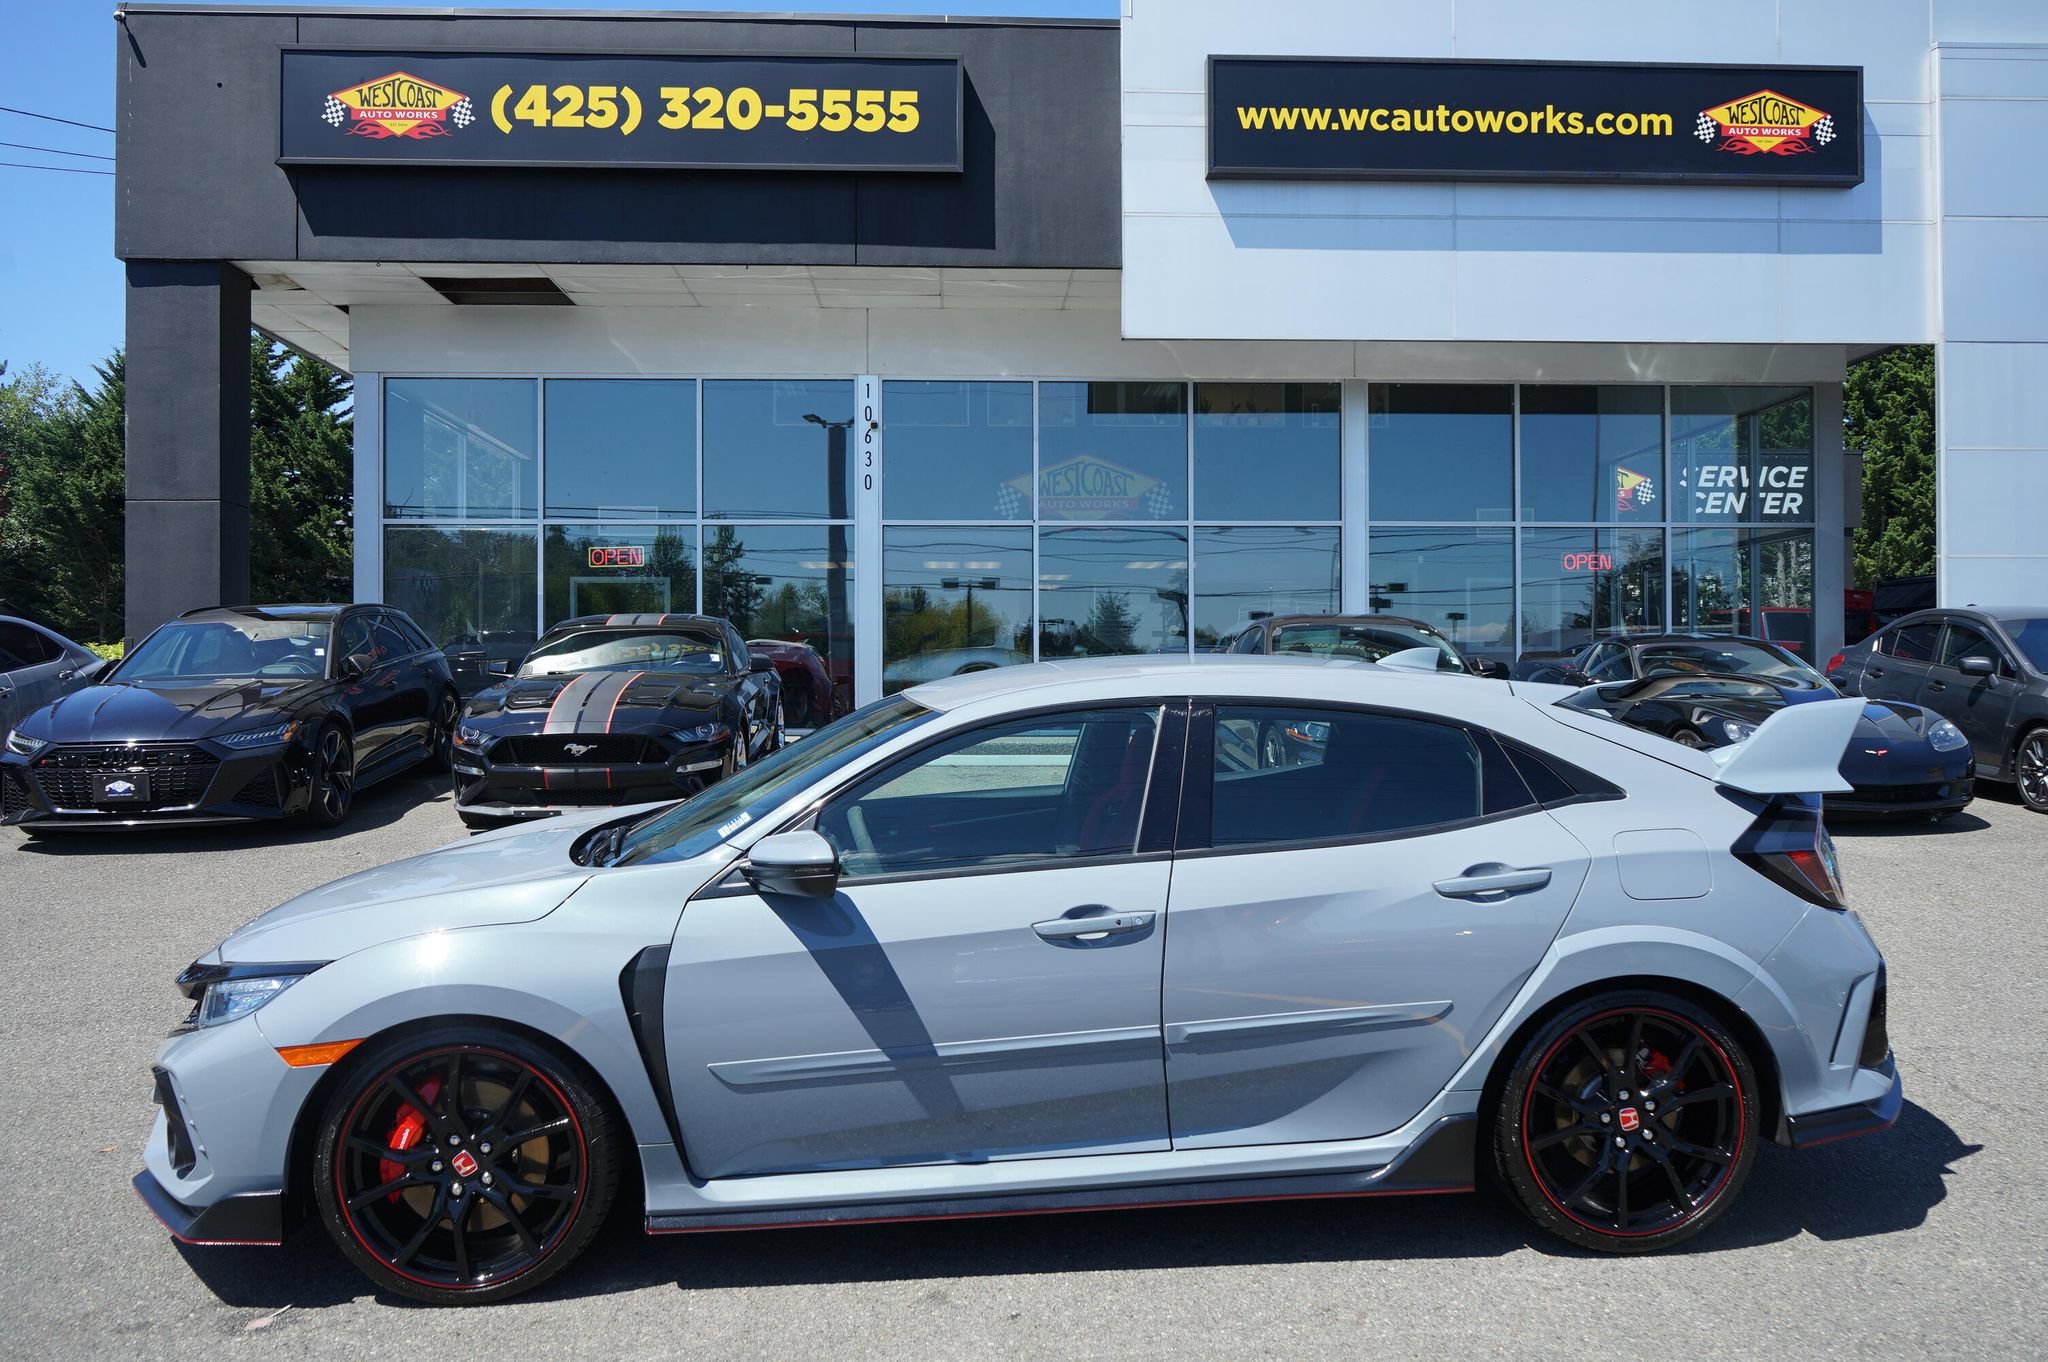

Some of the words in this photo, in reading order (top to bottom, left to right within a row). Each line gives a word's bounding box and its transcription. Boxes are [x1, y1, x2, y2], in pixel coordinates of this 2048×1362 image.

[359, 111, 394, 119] AUTO
[395, 111, 438, 119] WORKS
[491, 84, 643, 136] (425)
[657, 86, 921, 133] 320-5555
[1236, 104, 1673, 136] www.wcautoworks.com
[1728, 127, 1759, 135] AUTO
[1761, 128, 1802, 136] WORKS
[1079, 500, 1129, 509] WORKS
[591, 549, 642, 565] OPEN
[1563, 553, 1612, 570] OPEN
